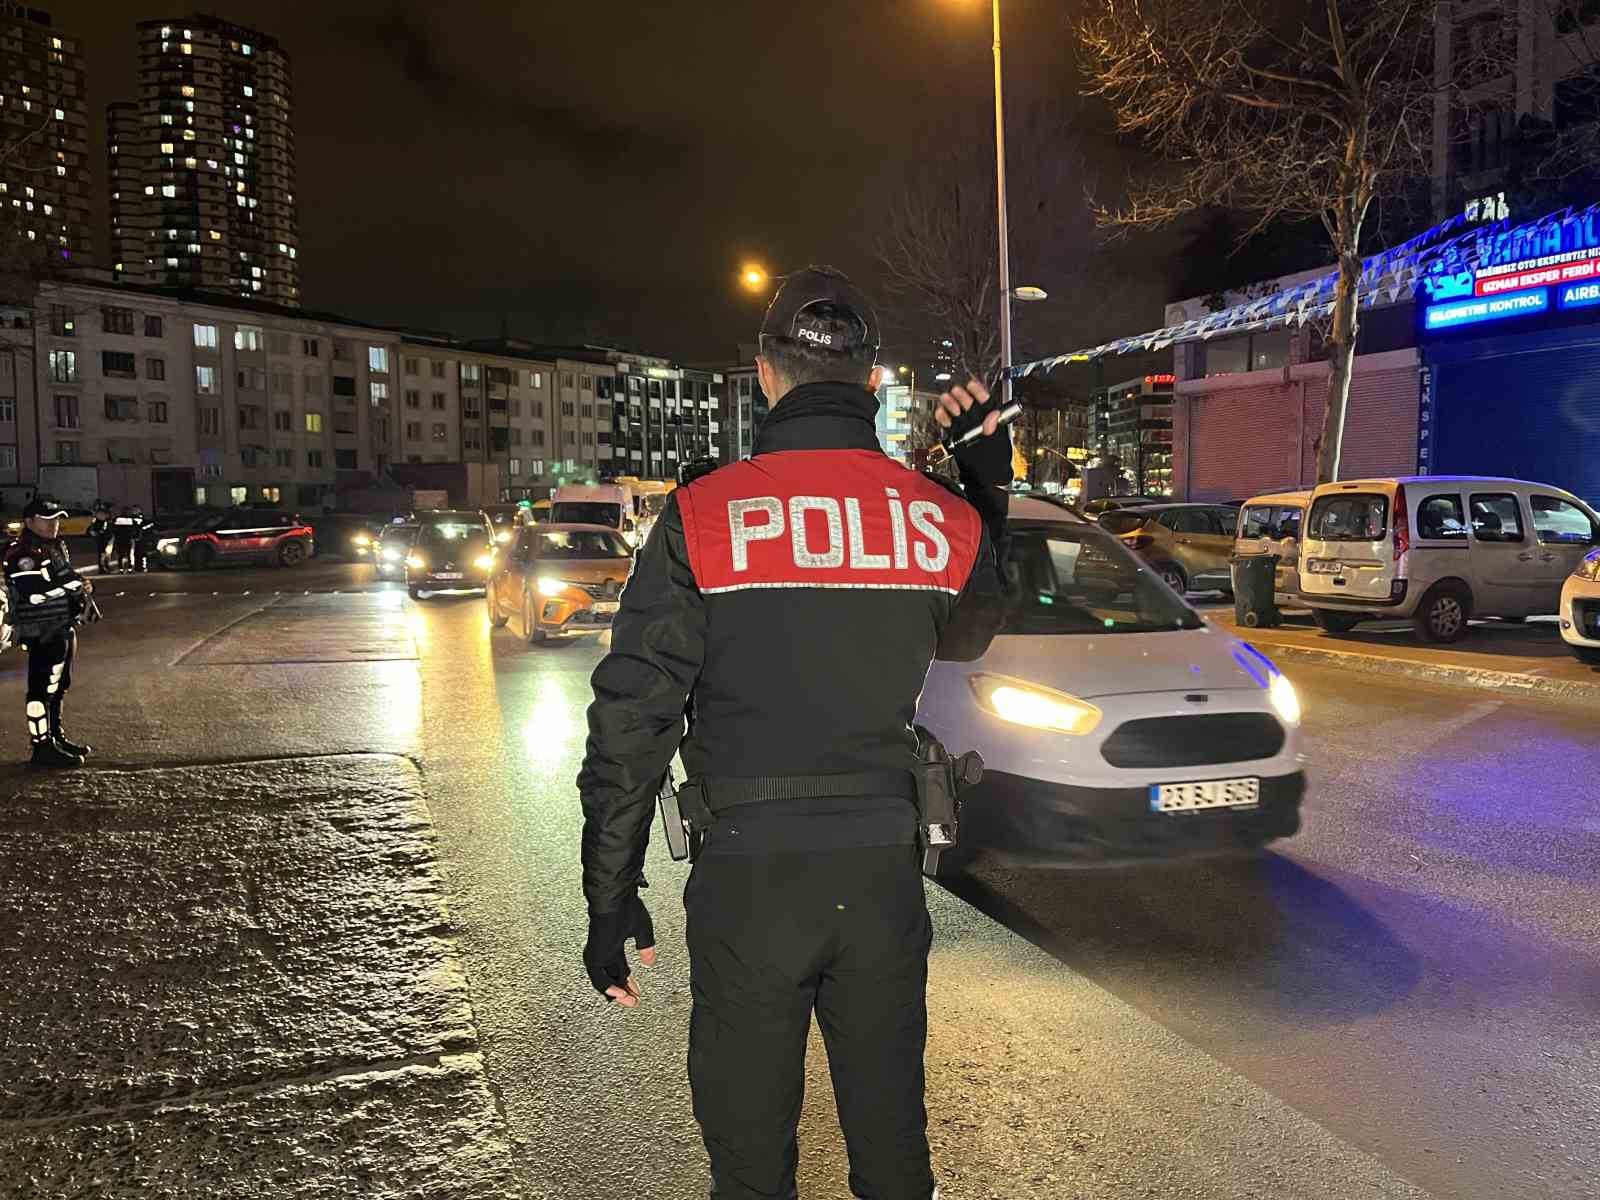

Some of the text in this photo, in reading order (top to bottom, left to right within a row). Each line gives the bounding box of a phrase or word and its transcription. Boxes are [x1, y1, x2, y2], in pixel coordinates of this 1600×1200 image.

[1518, 259, 1537, 271] OTO
[1520, 269, 1560, 286] EKSPER
[1562, 260, 1594, 278] FERDİ
[1489, 295, 1543, 312] KONTROL
[797, 328, 832, 345] POLİS
[728, 487, 950, 573] POLİS
